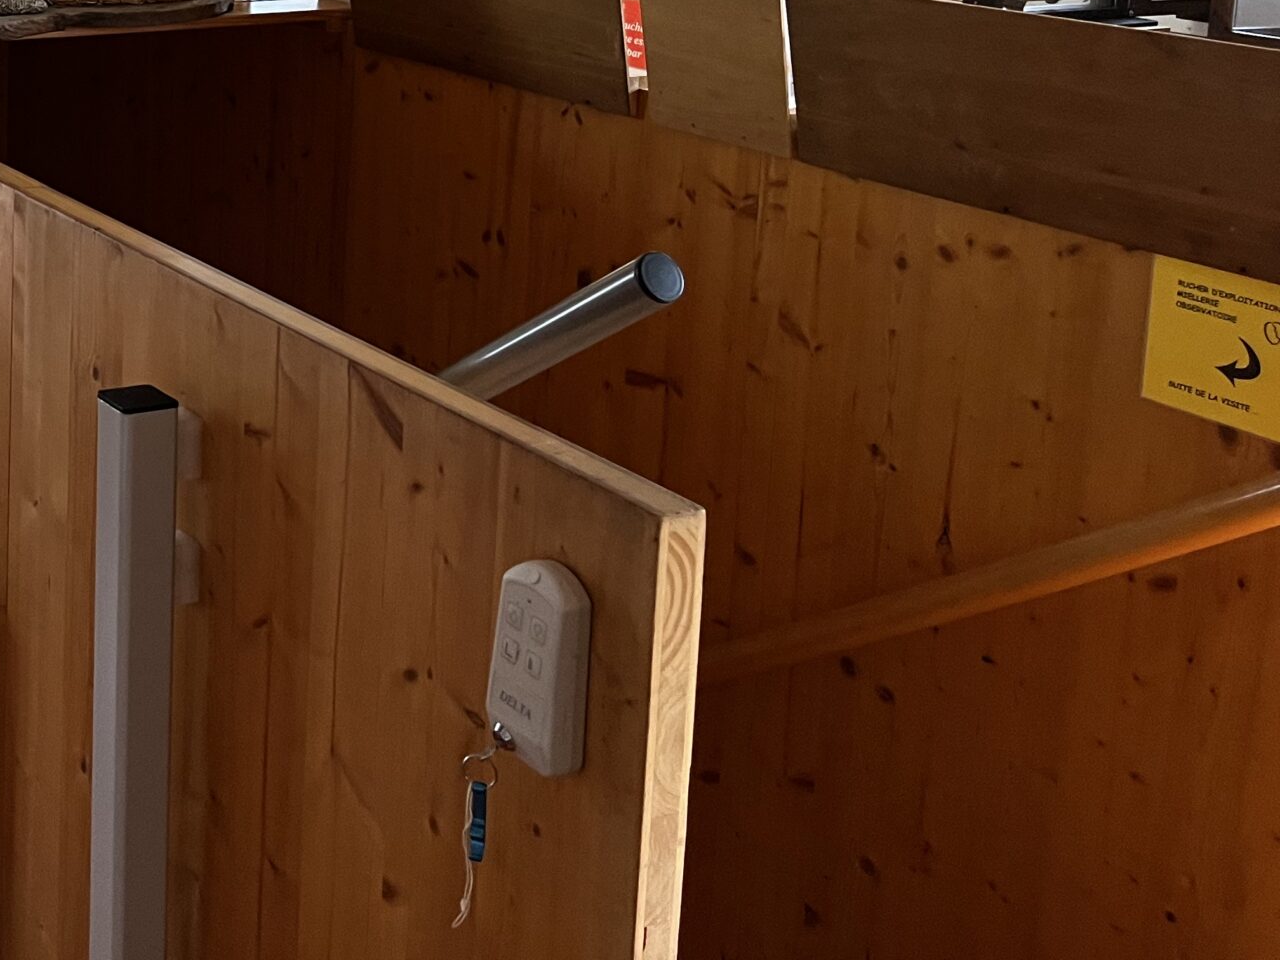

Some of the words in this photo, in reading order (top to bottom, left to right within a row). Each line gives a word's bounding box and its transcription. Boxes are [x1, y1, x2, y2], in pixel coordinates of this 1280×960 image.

[1177, 279, 1209, 293] RUCHER
[1176, 290, 1220, 308] MIELLERIE
[1175, 300, 1238, 324] OBSERVATOIRE
[1168, 380, 1193, 394] SUITE
[1195, 388, 1206, 398] DE
[1207, 392, 1219, 402] LA
[1221, 397, 1251, 413] VISITE
[498, 689, 532, 721] DELTA
